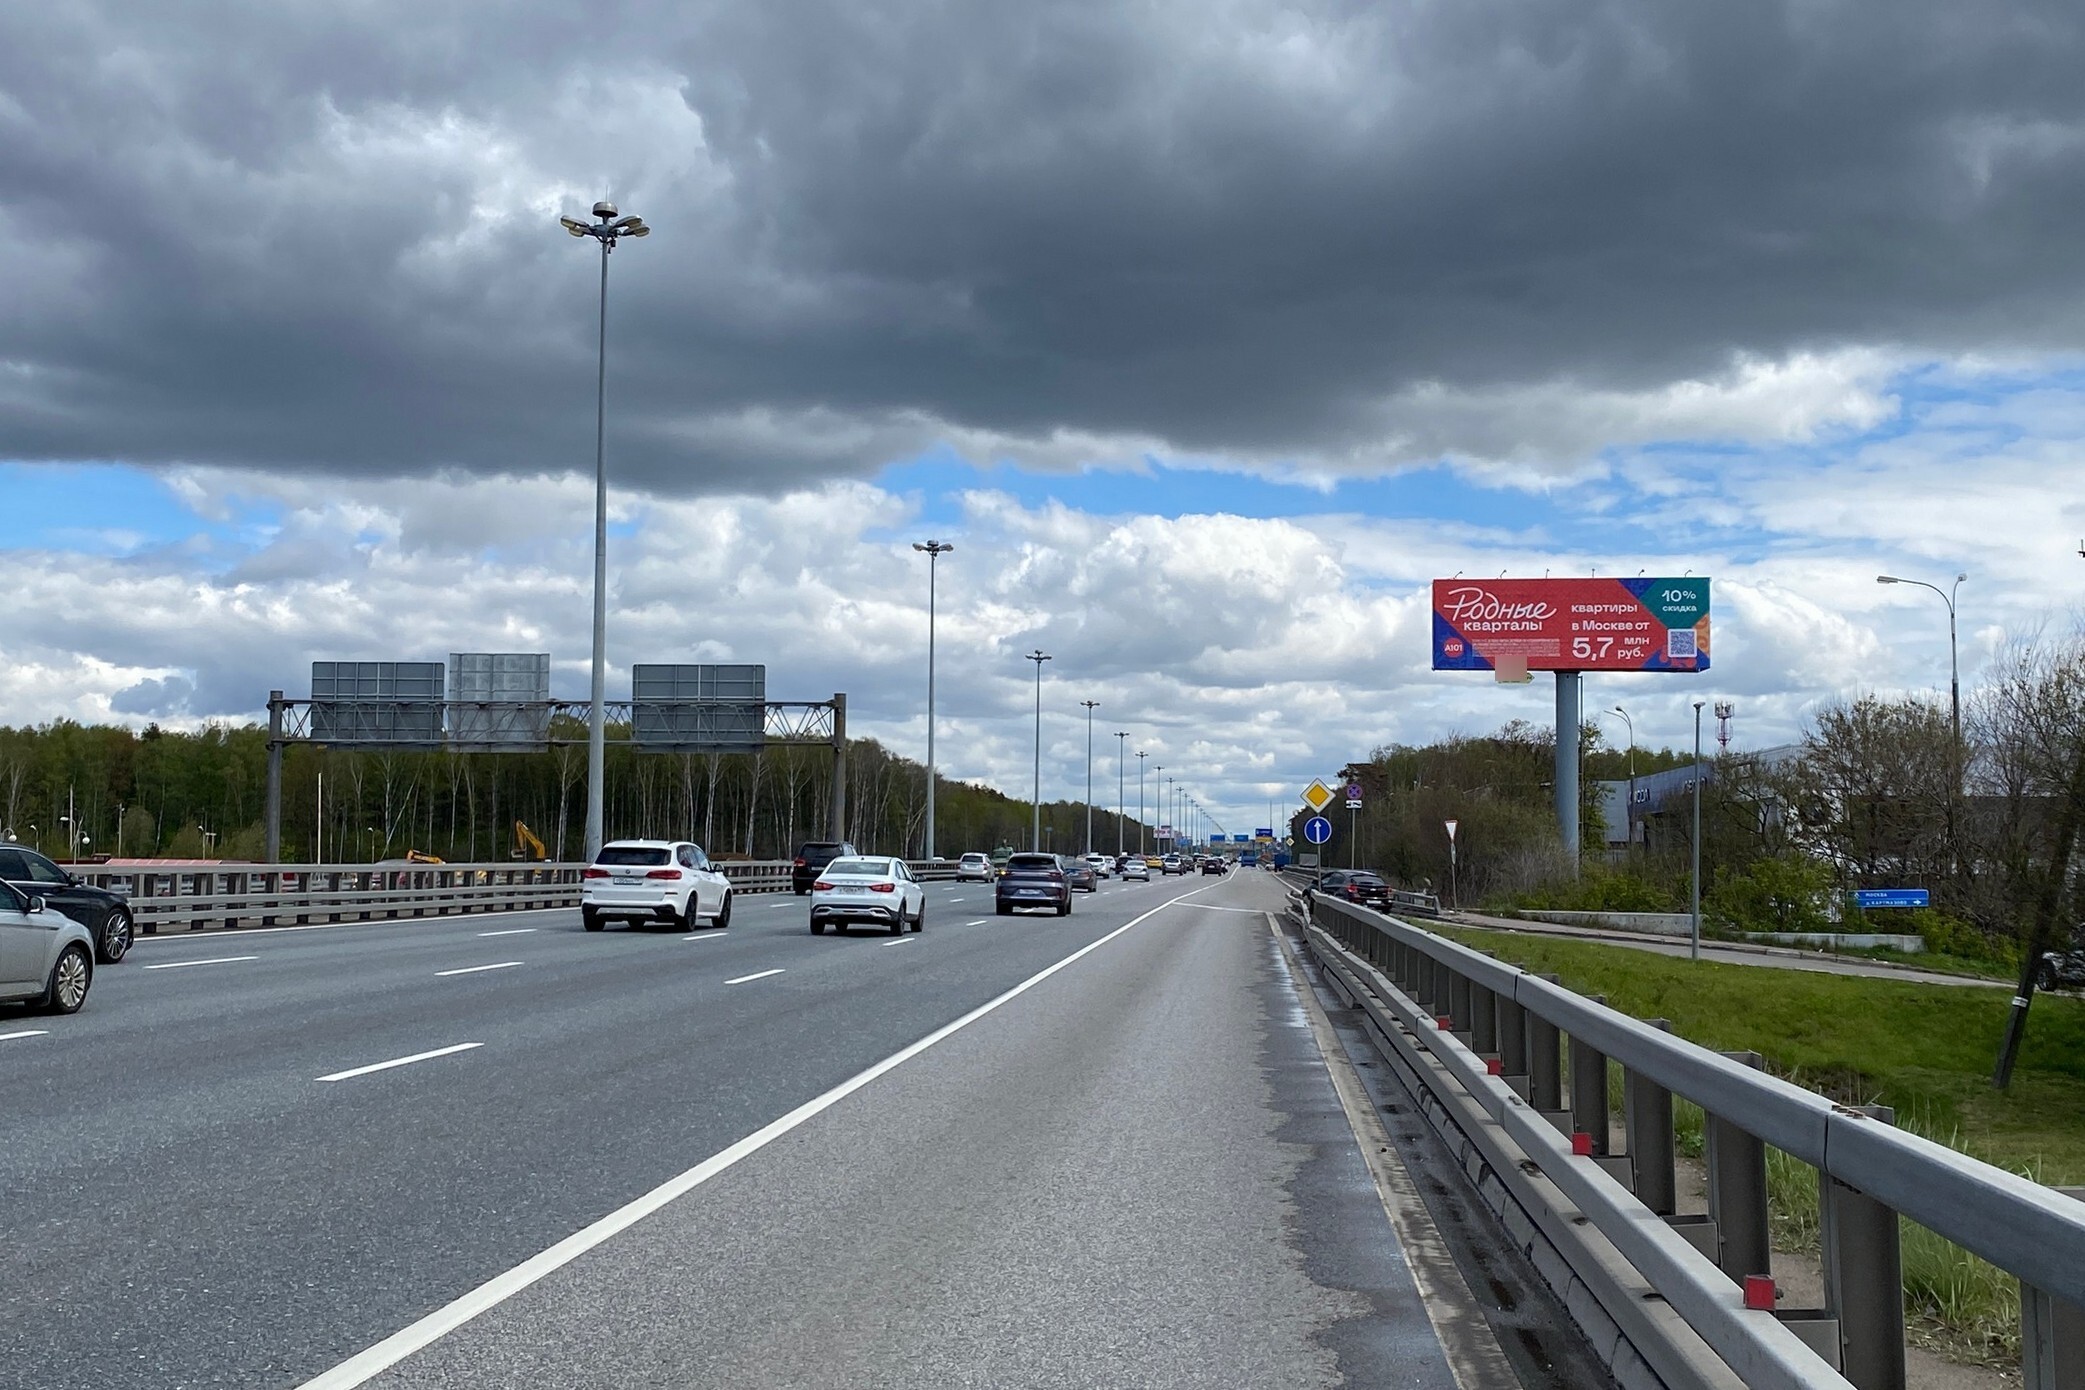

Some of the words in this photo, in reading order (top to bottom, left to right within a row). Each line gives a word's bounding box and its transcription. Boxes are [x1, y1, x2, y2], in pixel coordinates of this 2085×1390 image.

[1662, 590, 1697, 602] 10%
[1444, 587, 1557, 621] Родные
[1571, 604, 1638, 615] квартиры
[1662, 605, 1697, 613] скидка
[1463, 620, 1543, 632] кварталы
[1571, 621, 1580, 631] в
[1582, 620, 1633, 631] Москве
[1635, 621, 1650, 631] от
[1624, 637, 1650, 645] млн
[1572, 637, 1614, 662] 5,7
[1617, 648, 1645, 660] руб.
